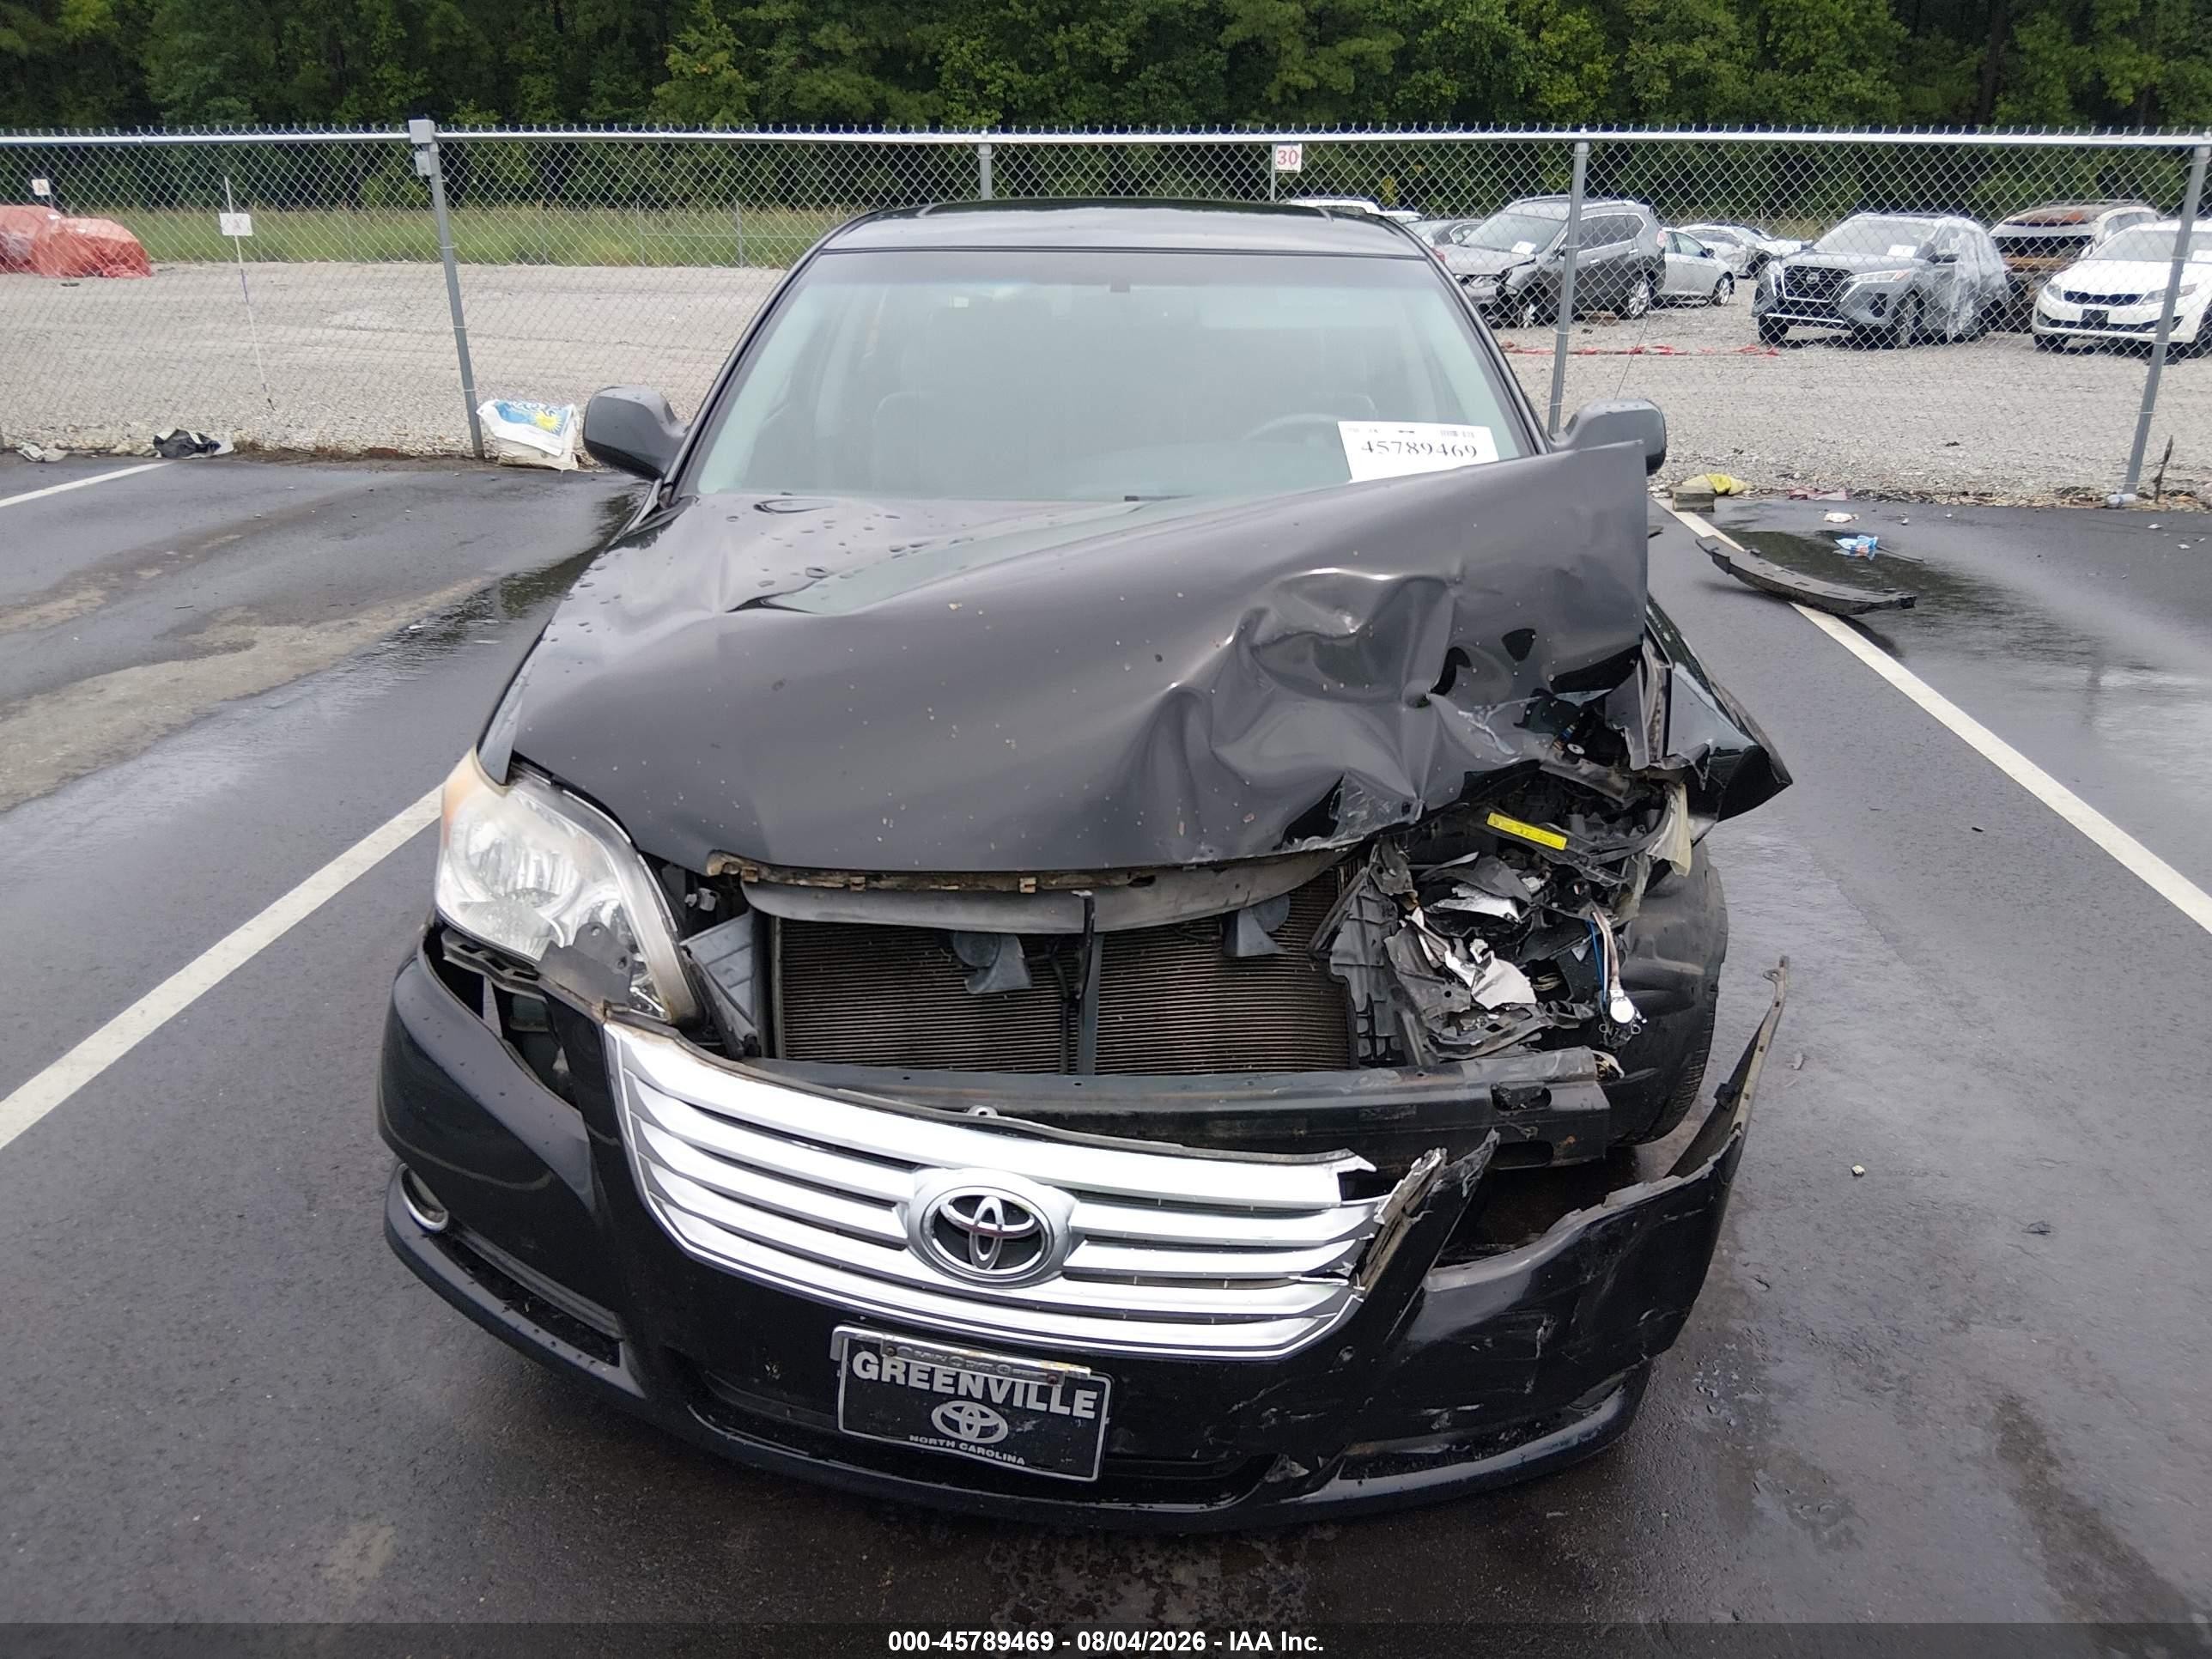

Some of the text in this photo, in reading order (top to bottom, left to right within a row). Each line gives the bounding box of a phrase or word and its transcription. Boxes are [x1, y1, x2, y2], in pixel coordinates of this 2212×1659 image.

[1277, 149, 1298, 165] 30
[1361, 440, 1477, 458] 45789469
[851, 1351, 1097, 1419] GREENVILLE
[908, 1434, 1025, 1466] NORTH CAROLINA
